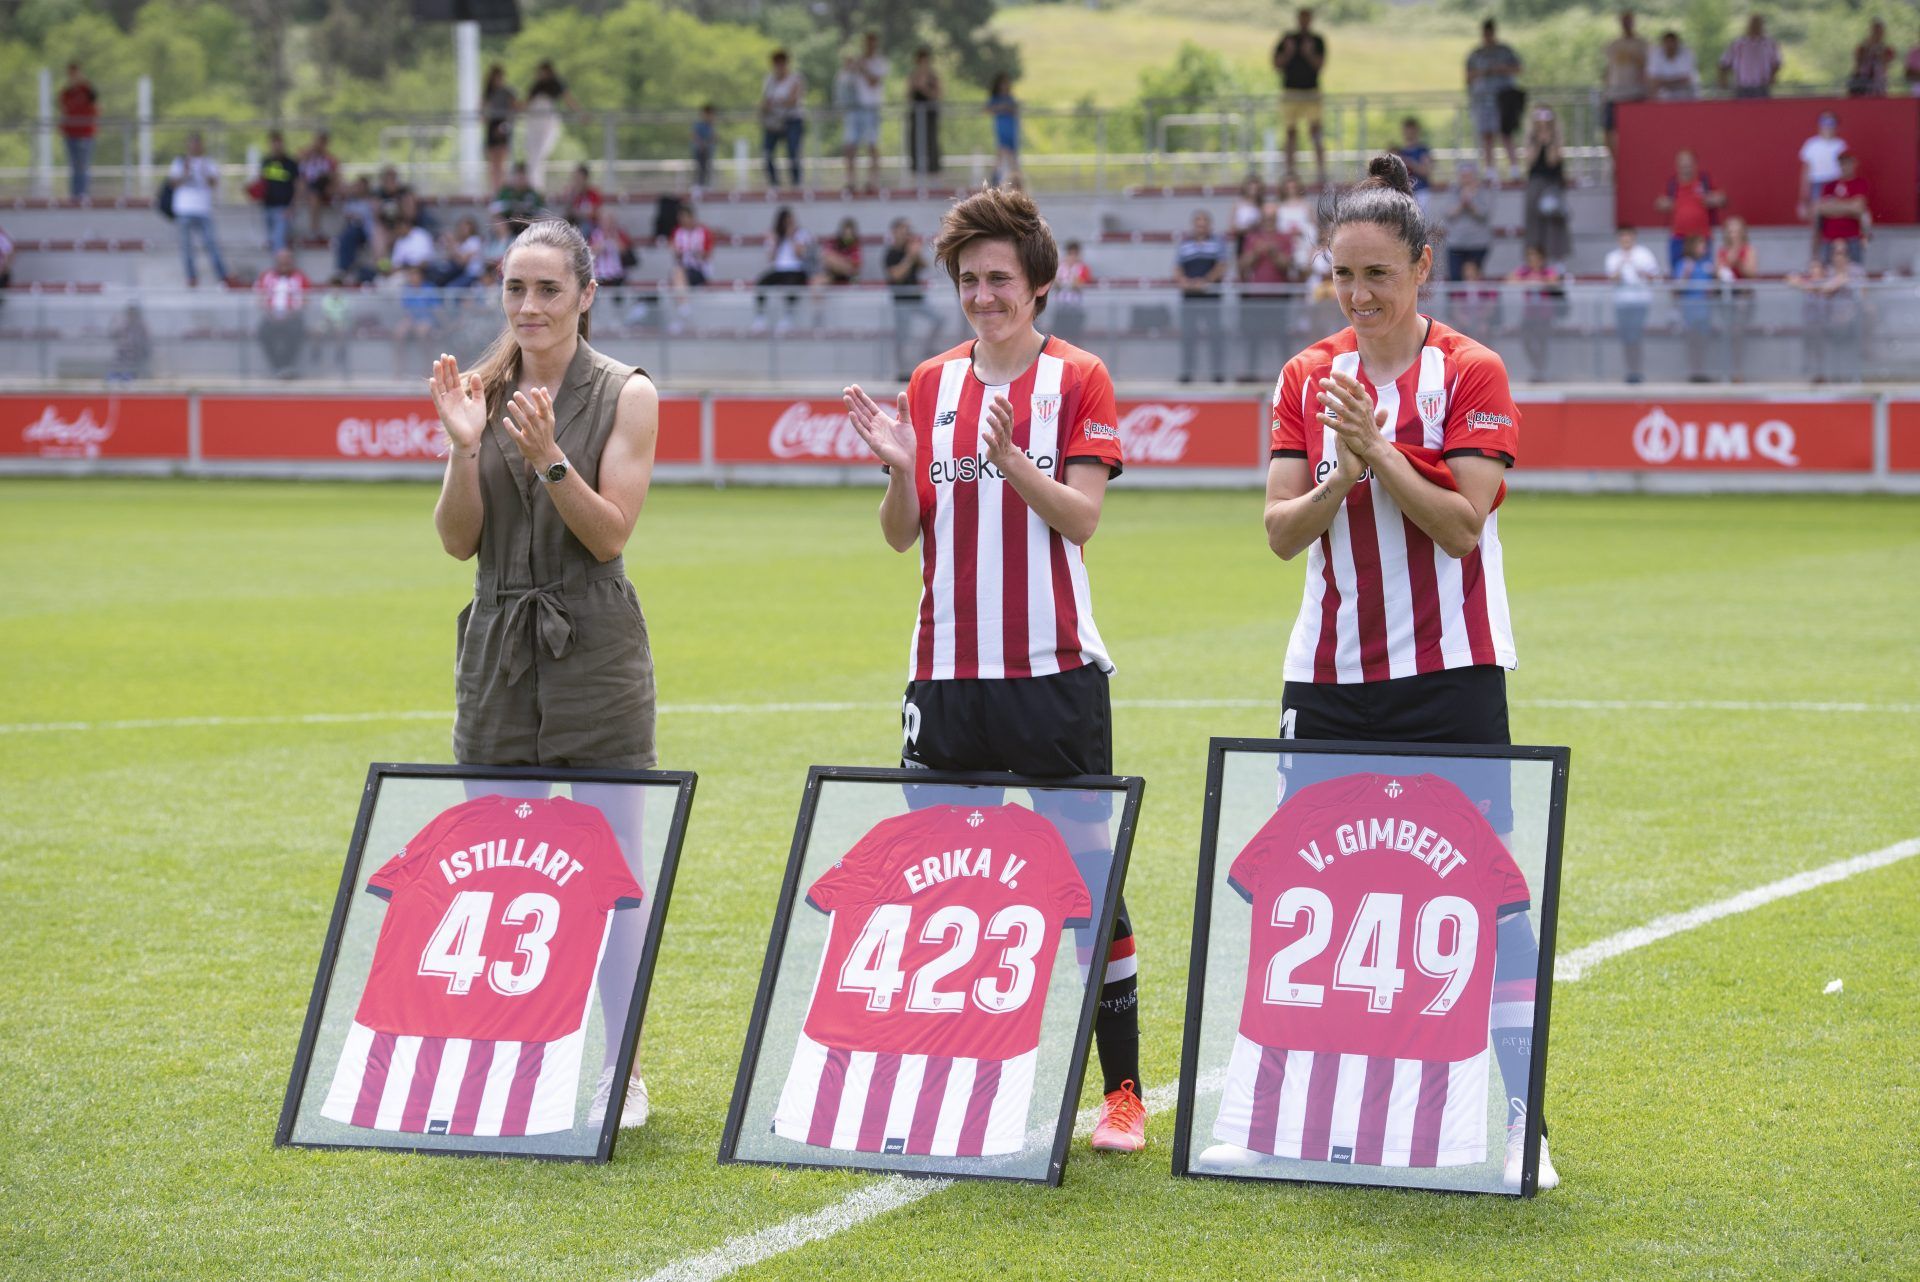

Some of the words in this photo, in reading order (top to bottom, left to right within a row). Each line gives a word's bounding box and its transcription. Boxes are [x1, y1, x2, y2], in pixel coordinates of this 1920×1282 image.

[439, 838, 584, 887] ISTILLART
[903, 848, 991, 894] ERIKA
[999, 853, 1027, 889] V.
[1298, 840, 1335, 873] V.
[1335, 818, 1467, 879] GIMBERT
[418, 890, 561, 997] 43
[837, 904, 1045, 1014] 423
[1263, 887, 1479, 1015] 249
